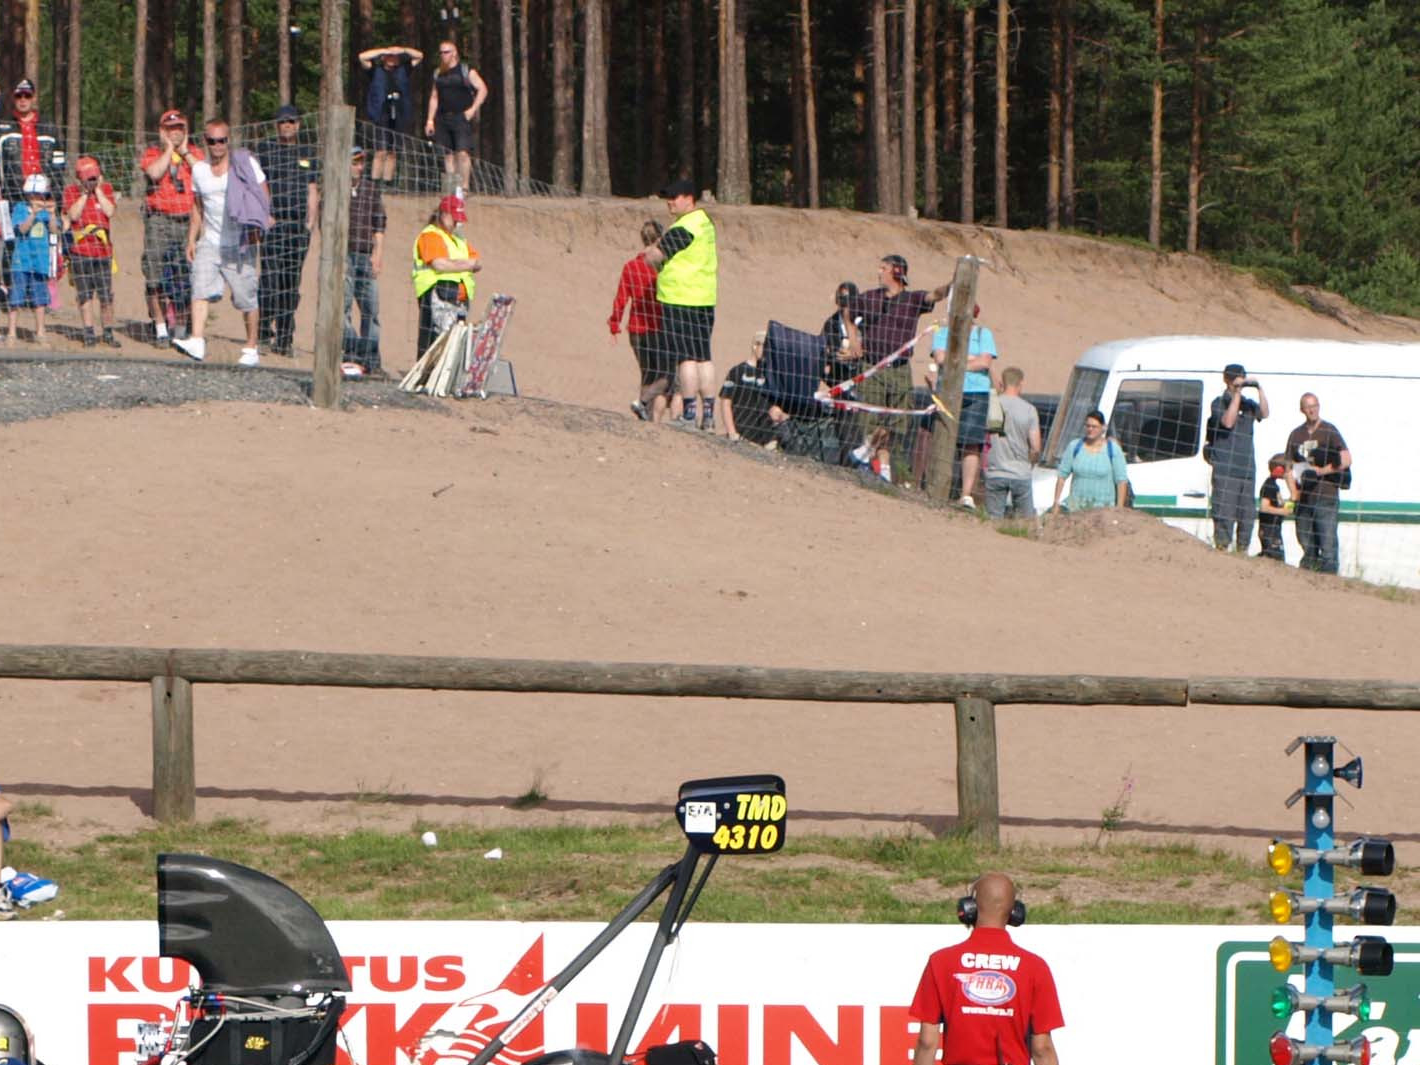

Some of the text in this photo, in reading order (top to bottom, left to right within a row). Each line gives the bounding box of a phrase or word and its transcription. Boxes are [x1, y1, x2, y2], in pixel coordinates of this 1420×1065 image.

[737, 794, 787, 821] TMD
[713, 824, 779, 850] 4310
[961, 953, 1021, 972] CREW
